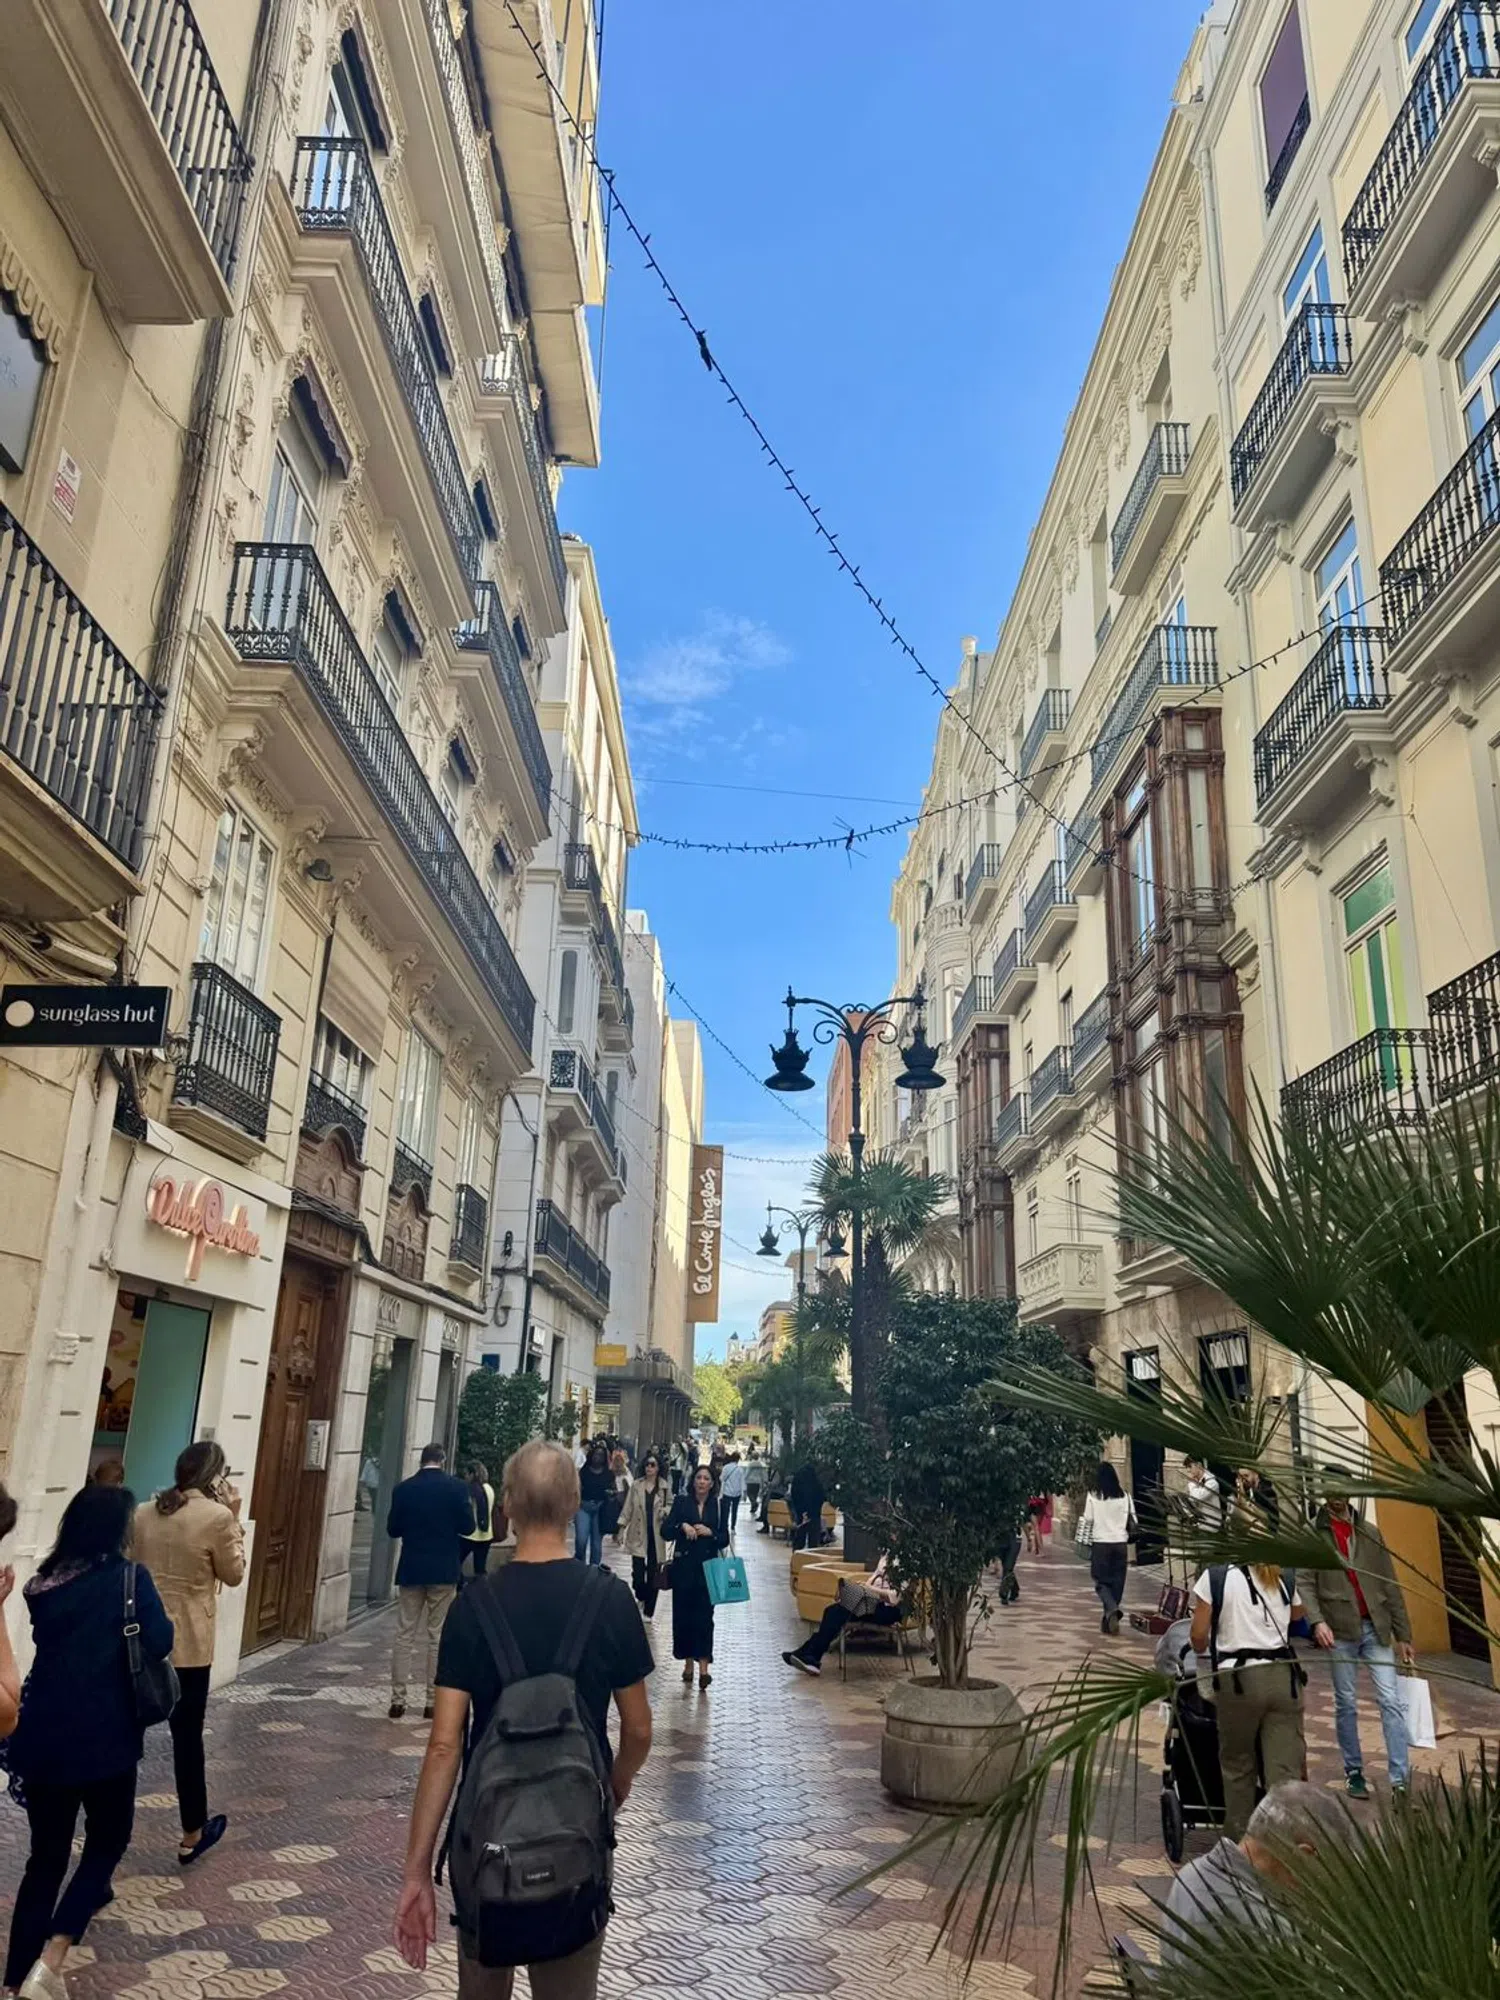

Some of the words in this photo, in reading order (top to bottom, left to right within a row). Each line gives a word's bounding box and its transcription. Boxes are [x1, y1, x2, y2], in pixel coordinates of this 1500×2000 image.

[39, 1004, 120, 1027] sunglass
[123, 1004, 156, 1023] hut
[692, 1167, 721, 1229] Inglés
[694, 1229, 714, 1273] Corte
[693, 1274, 712, 1295] El
[378, 1294, 402, 1324] KIKO
[443, 1319, 460, 1343] KIKO
